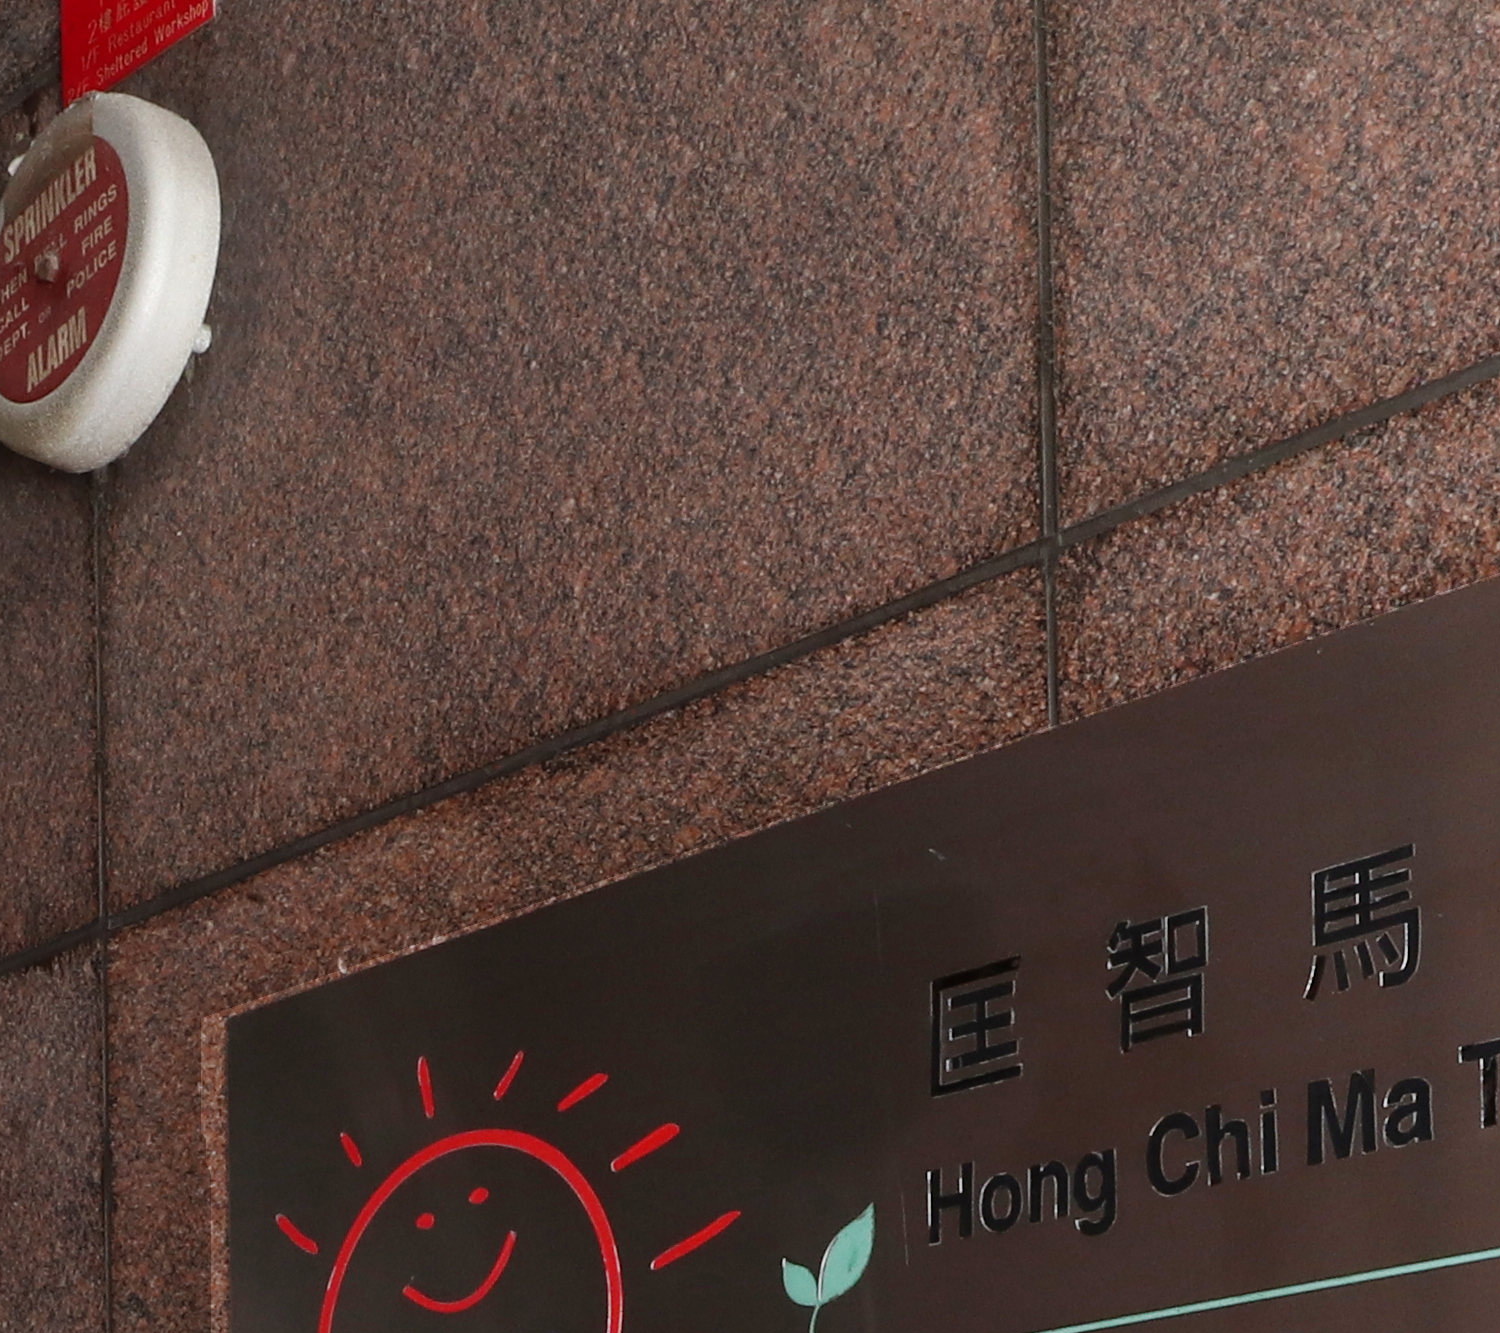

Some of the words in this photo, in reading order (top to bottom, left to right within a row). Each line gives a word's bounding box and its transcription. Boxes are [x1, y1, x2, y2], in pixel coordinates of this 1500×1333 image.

[96, 37, 149, 87] Sheltered
[153, 0, 210, 46] Workshop
[3, 145, 98, 265] SPRINKLER
[74, 184, 118, 235] RINGS
[81, 214, 115, 257] FIRE
[65, 238, 118, 299] POLICE
[26, 305, 89, 394] ALARM
[925, 1147, 1118, 1247] Hong
[1145, 1087, 1279, 1197] Chi
[1306, 1067, 1436, 1167] Ma
